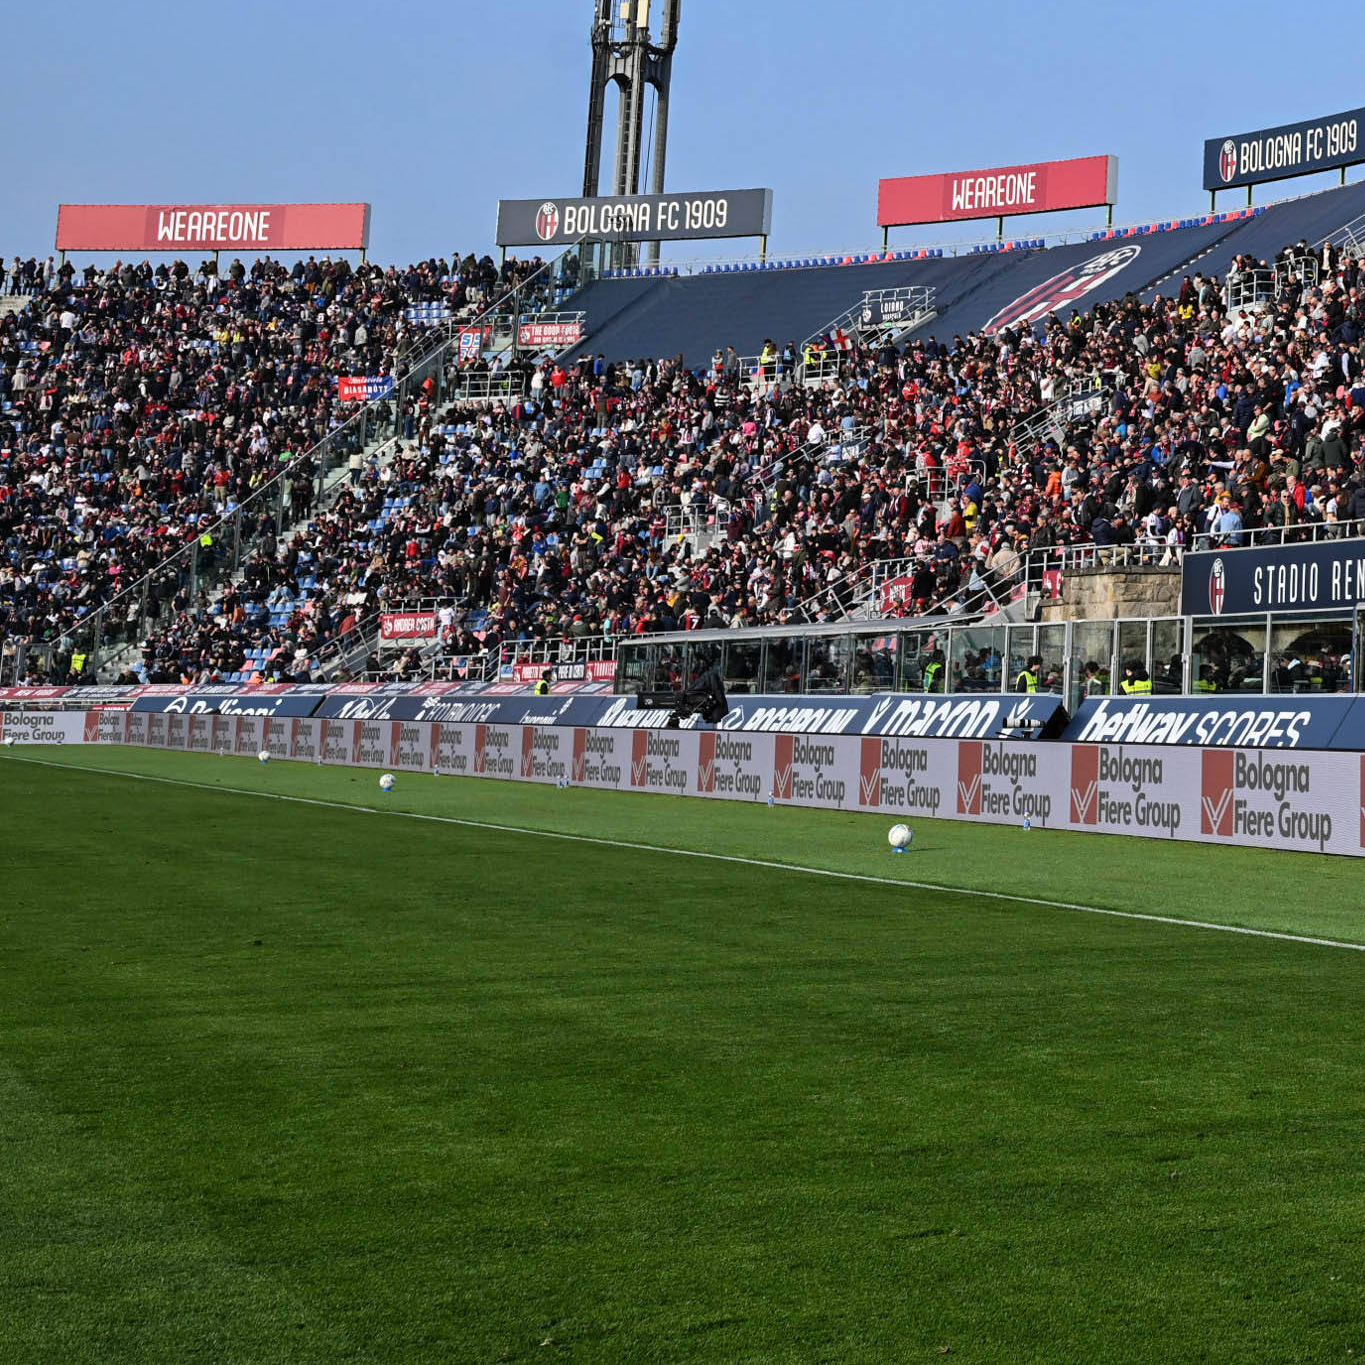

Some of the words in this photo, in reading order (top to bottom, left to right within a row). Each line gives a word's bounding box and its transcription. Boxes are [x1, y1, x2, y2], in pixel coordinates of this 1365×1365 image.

[1240, 133, 1303, 175] BOLOGNA
[1306, 128, 1323, 160] FC
[1326, 119, 1358, 156] 1909
[952, 172, 1036, 210] WEAREONE
[157, 211, 270, 242] WEAREONE
[564, 203, 650, 234] BOLOGNA
[657, 201, 680, 231] FC
[685, 199, 728, 229] 1909
[1253, 562, 1320, 605] STADIO
[880, 699, 1000, 738] macron
[586, 730, 614, 757] Bologna
[648, 732, 679, 762] Bologna
[716, 734, 752, 766] Bologna
[794, 736, 834, 771] Bologna
[882, 738, 928, 780] Bologna
[584, 756, 600, 780] Fiere
[600, 758, 621, 788] Group
[646, 760, 664, 784] Fiere
[665, 763, 687, 794] Group
[983, 742, 1036, 784] Bologna
[1100, 746, 1163, 792] Bologna
[1235, 751, 1310, 800] Bologna
[714, 764, 733, 792] Fiere
[735, 767, 761, 801] Group
[792, 770, 814, 798] Fiere
[816, 772, 845, 807] Group
[880, 776, 904, 807] Fiere
[907, 781, 940, 816] Group
[981, 783, 1011, 815] Fiere
[1013, 785, 1051, 827] Group
[1098, 792, 1131, 826] Fiere
[1135, 794, 1181, 837] Group
[1234, 800, 1274, 839] Fiere
[1278, 802, 1332, 851] Group
